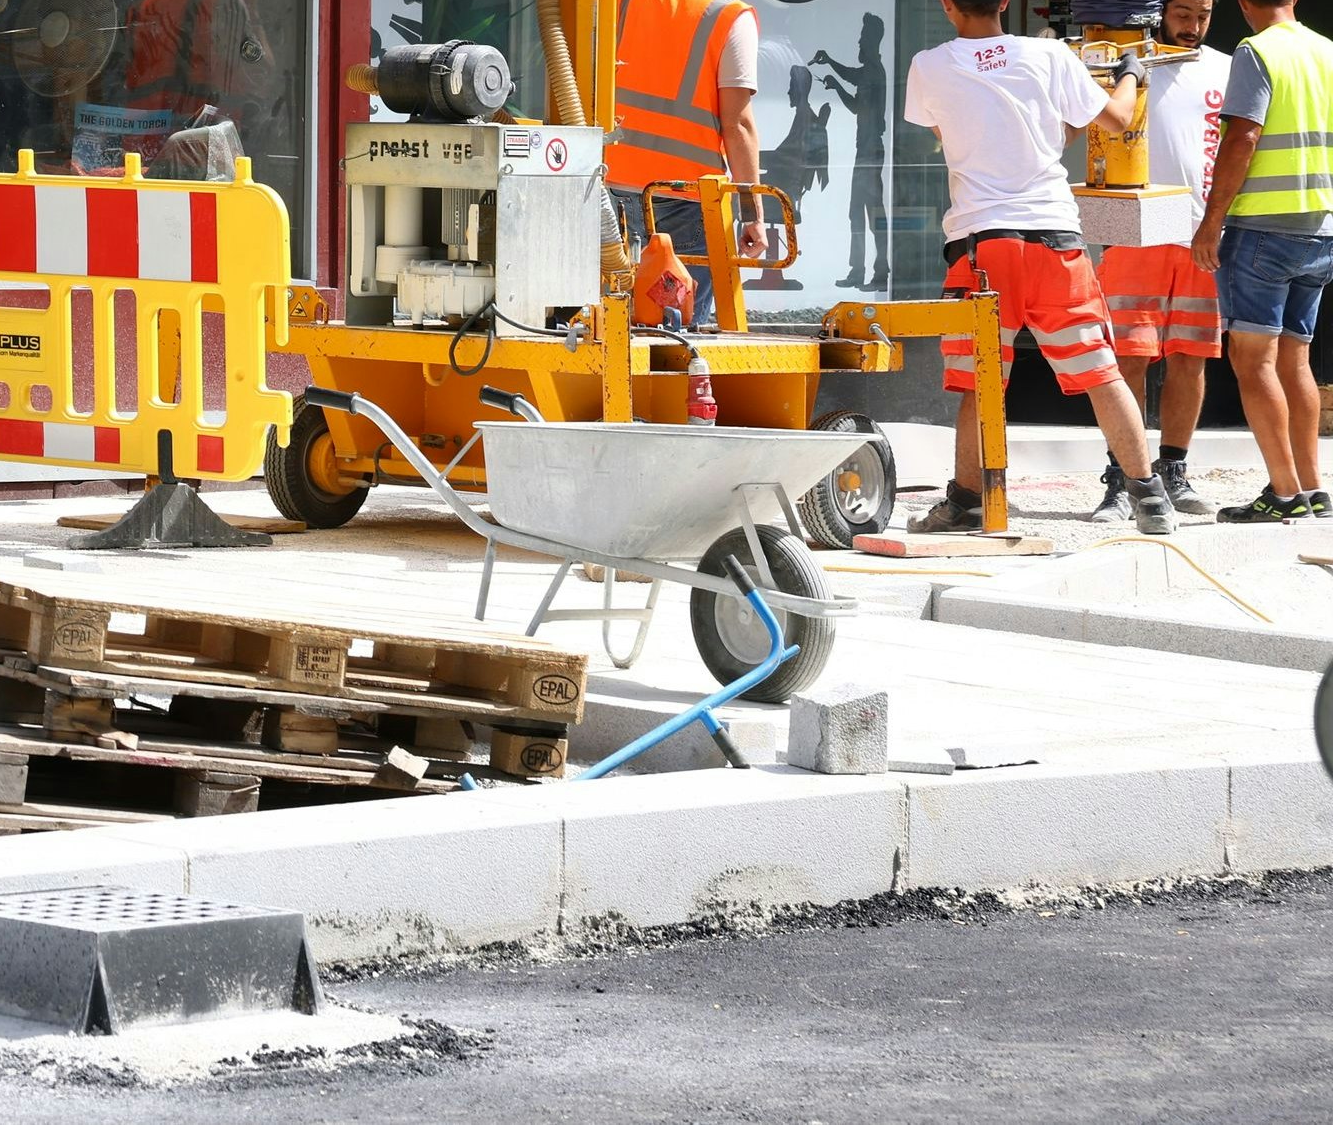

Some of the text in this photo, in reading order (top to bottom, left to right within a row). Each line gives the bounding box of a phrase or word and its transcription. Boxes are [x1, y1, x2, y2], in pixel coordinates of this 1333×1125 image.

[976, 59, 1007, 73] Safety
[80, 114, 167, 130] THE GOLDEN TORCH
[369, 138, 429, 161] probst
[539, 680, 572, 700] EPAL
[526, 749, 555, 767] EPAL
